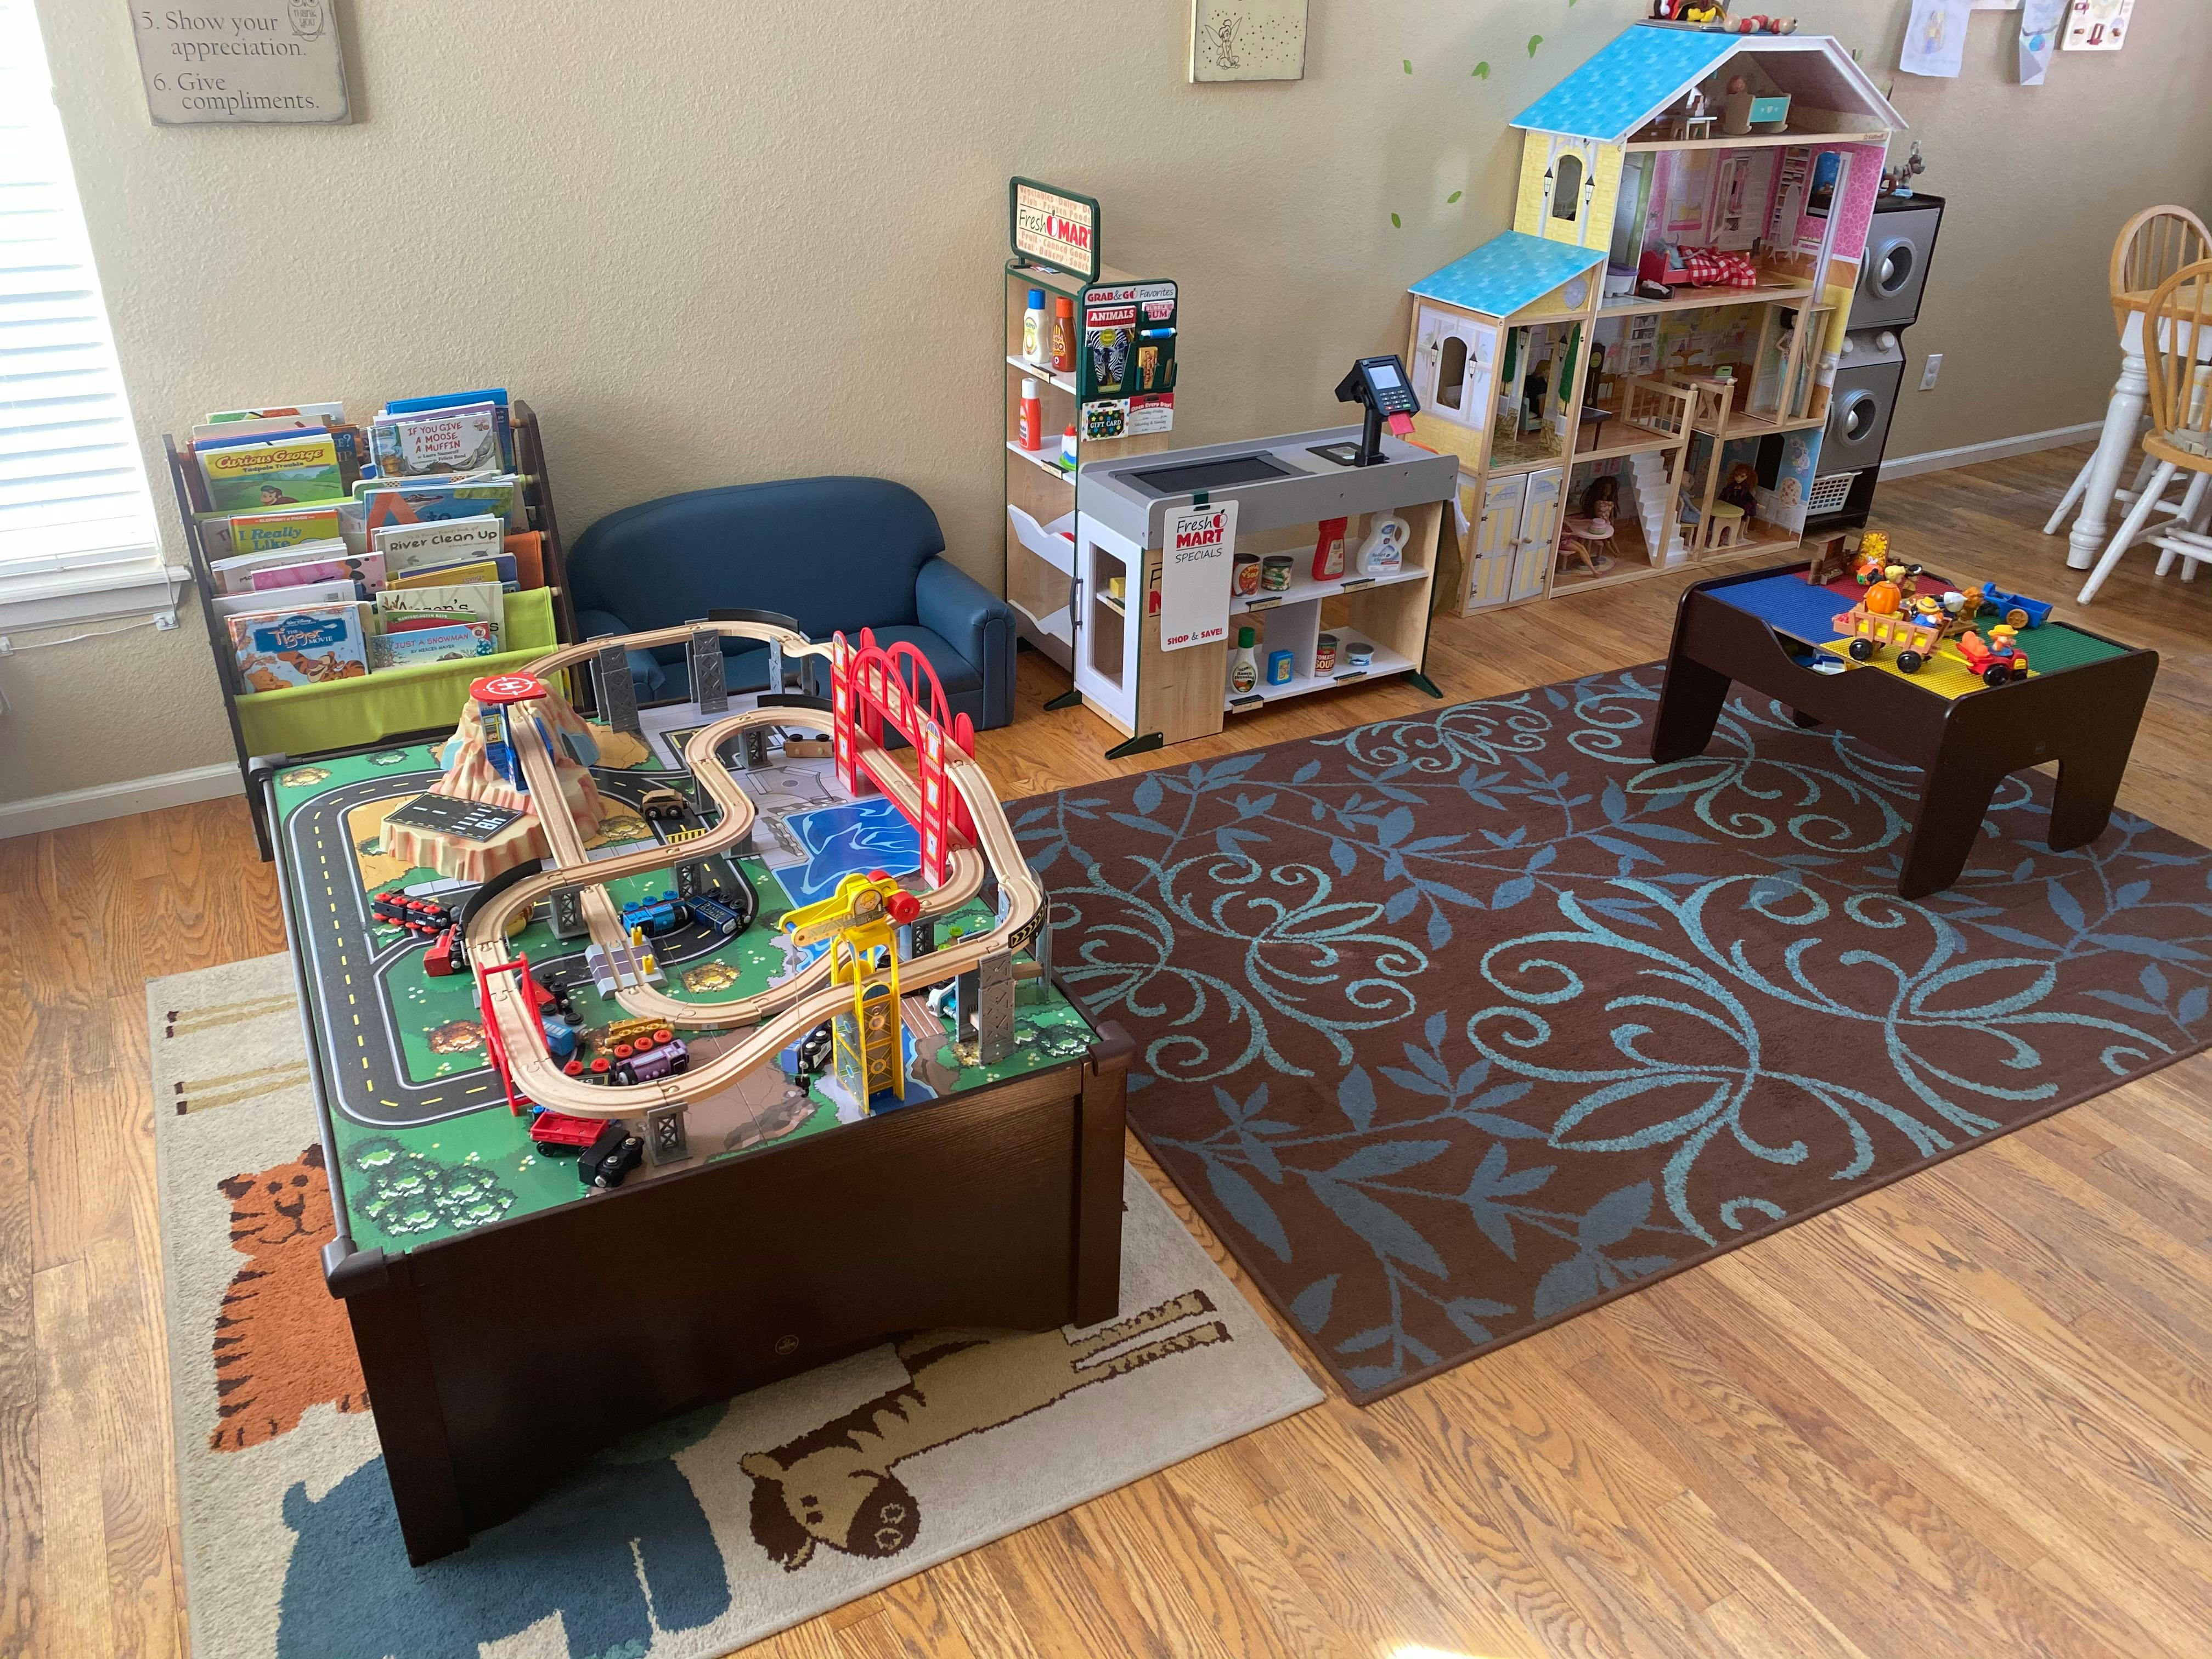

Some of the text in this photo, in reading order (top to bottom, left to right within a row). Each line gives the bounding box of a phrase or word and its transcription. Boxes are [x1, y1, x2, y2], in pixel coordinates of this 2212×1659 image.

[141, 10, 278, 36] 5. Show your
[171, 38, 307, 61] appreciation.
[153, 72, 228, 92] 6. Give
[182, 90, 320, 115] compliments.
[1019, 209, 1092, 250] Fresh MART
[1139, 287, 1173, 299] Favorites
[1090, 309, 1134, 321] ANIMALS
[407, 427, 416, 436] IF
[420, 425, 437, 435] YOU
[439, 421, 462, 432] GIVE
[1106, 419, 1121, 427] CARD
[415, 432, 458, 445] A MOOSE
[415, 439, 461, 454] A MUFFIN
[216, 449, 325, 470] Curious George
[242, 465, 273, 473] Tadpole
[1177, 516, 1211, 533] Fresh
[238, 530, 245, 541] I
[250, 526, 302, 539] Really
[390, 531, 498, 551] River Clean Up
[1176, 528, 1224, 549] MART
[253, 539, 290, 551] Like
[1175, 547, 1223, 563] SPECIALS
[267, 628, 324, 649] Tigger
[309, 636, 334, 645] MOVIE
[394, 640, 415, 650] JUST
[427, 633, 469, 645] SNOWMAN
[1167, 627, 1223, 645] SHOP & SAVE!
[1316, 659, 1334, 669] SOUP
[497, 681, 523, 691] H
